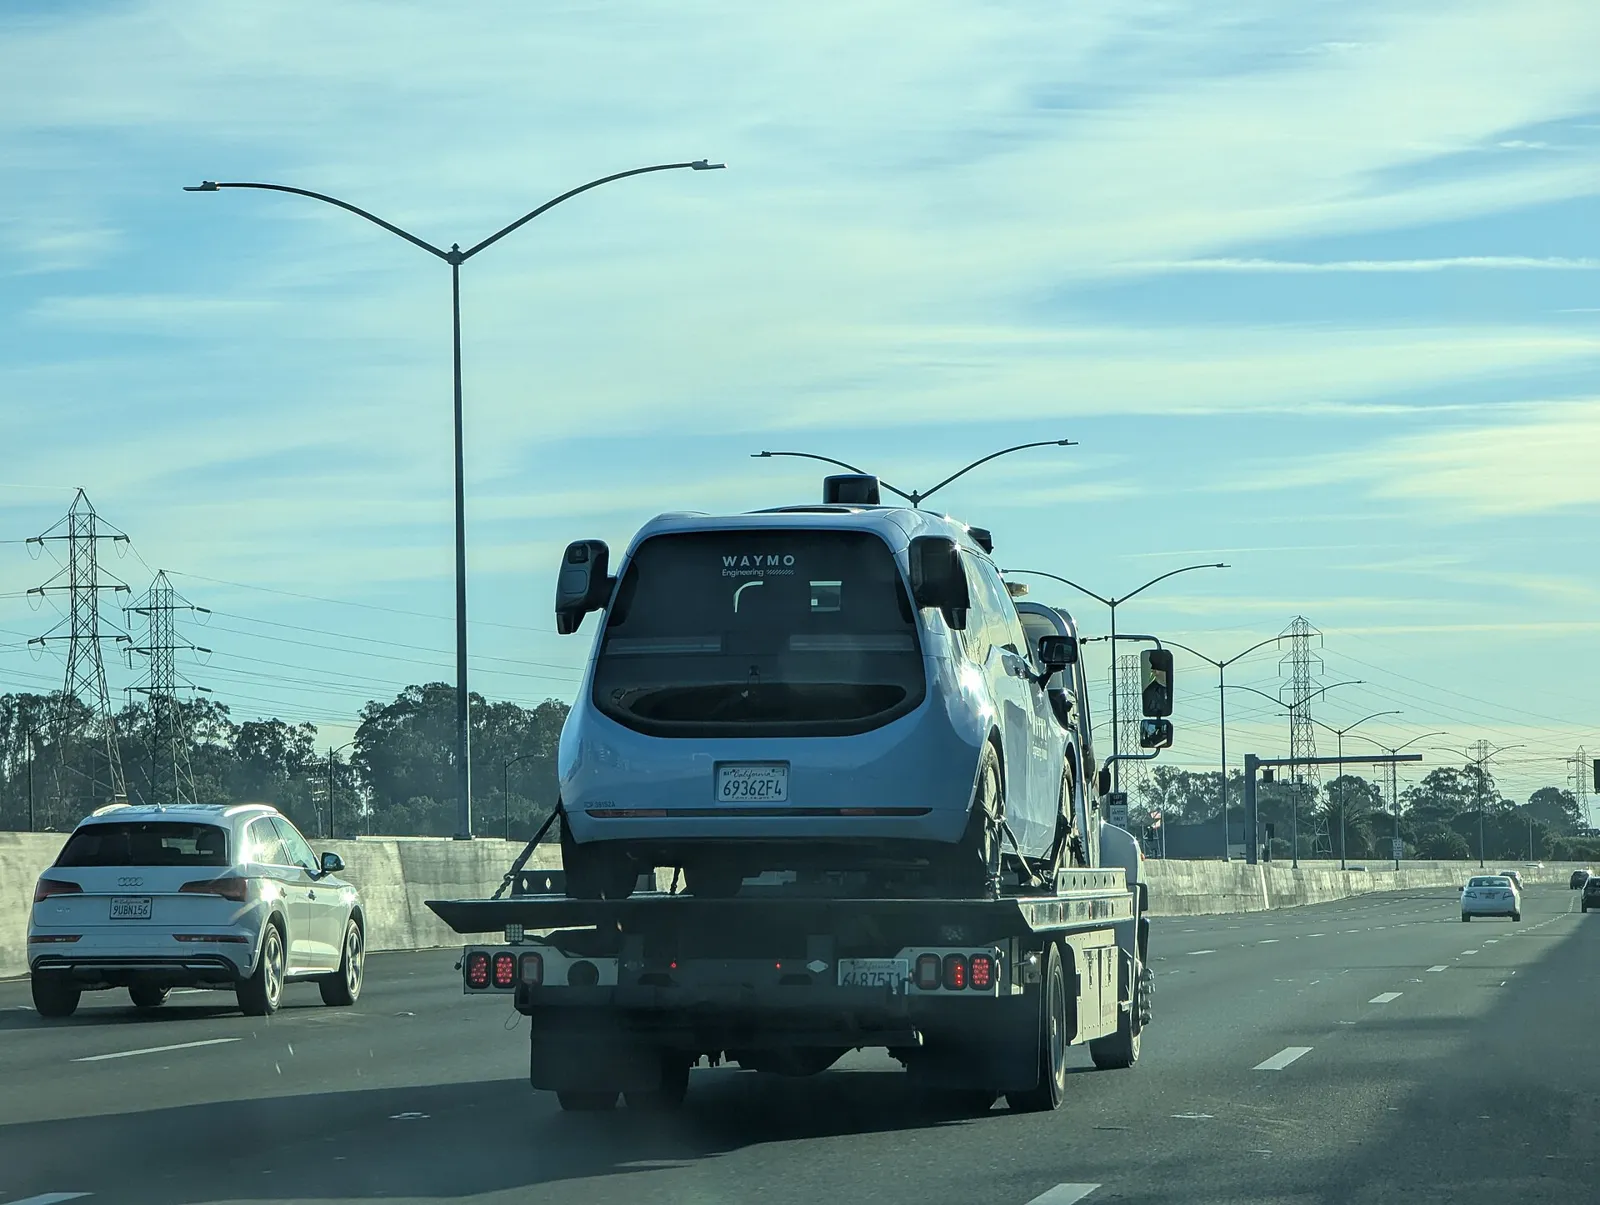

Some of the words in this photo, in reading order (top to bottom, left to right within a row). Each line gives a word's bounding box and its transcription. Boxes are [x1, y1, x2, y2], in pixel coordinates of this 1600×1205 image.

[722, 555, 795, 567] WAYMO
[722, 569, 764, 578] Engineering
[733, 769, 771, 780] California
[723, 780, 782, 796] 69362F4
[113, 905, 149, 915] 9UBN156
